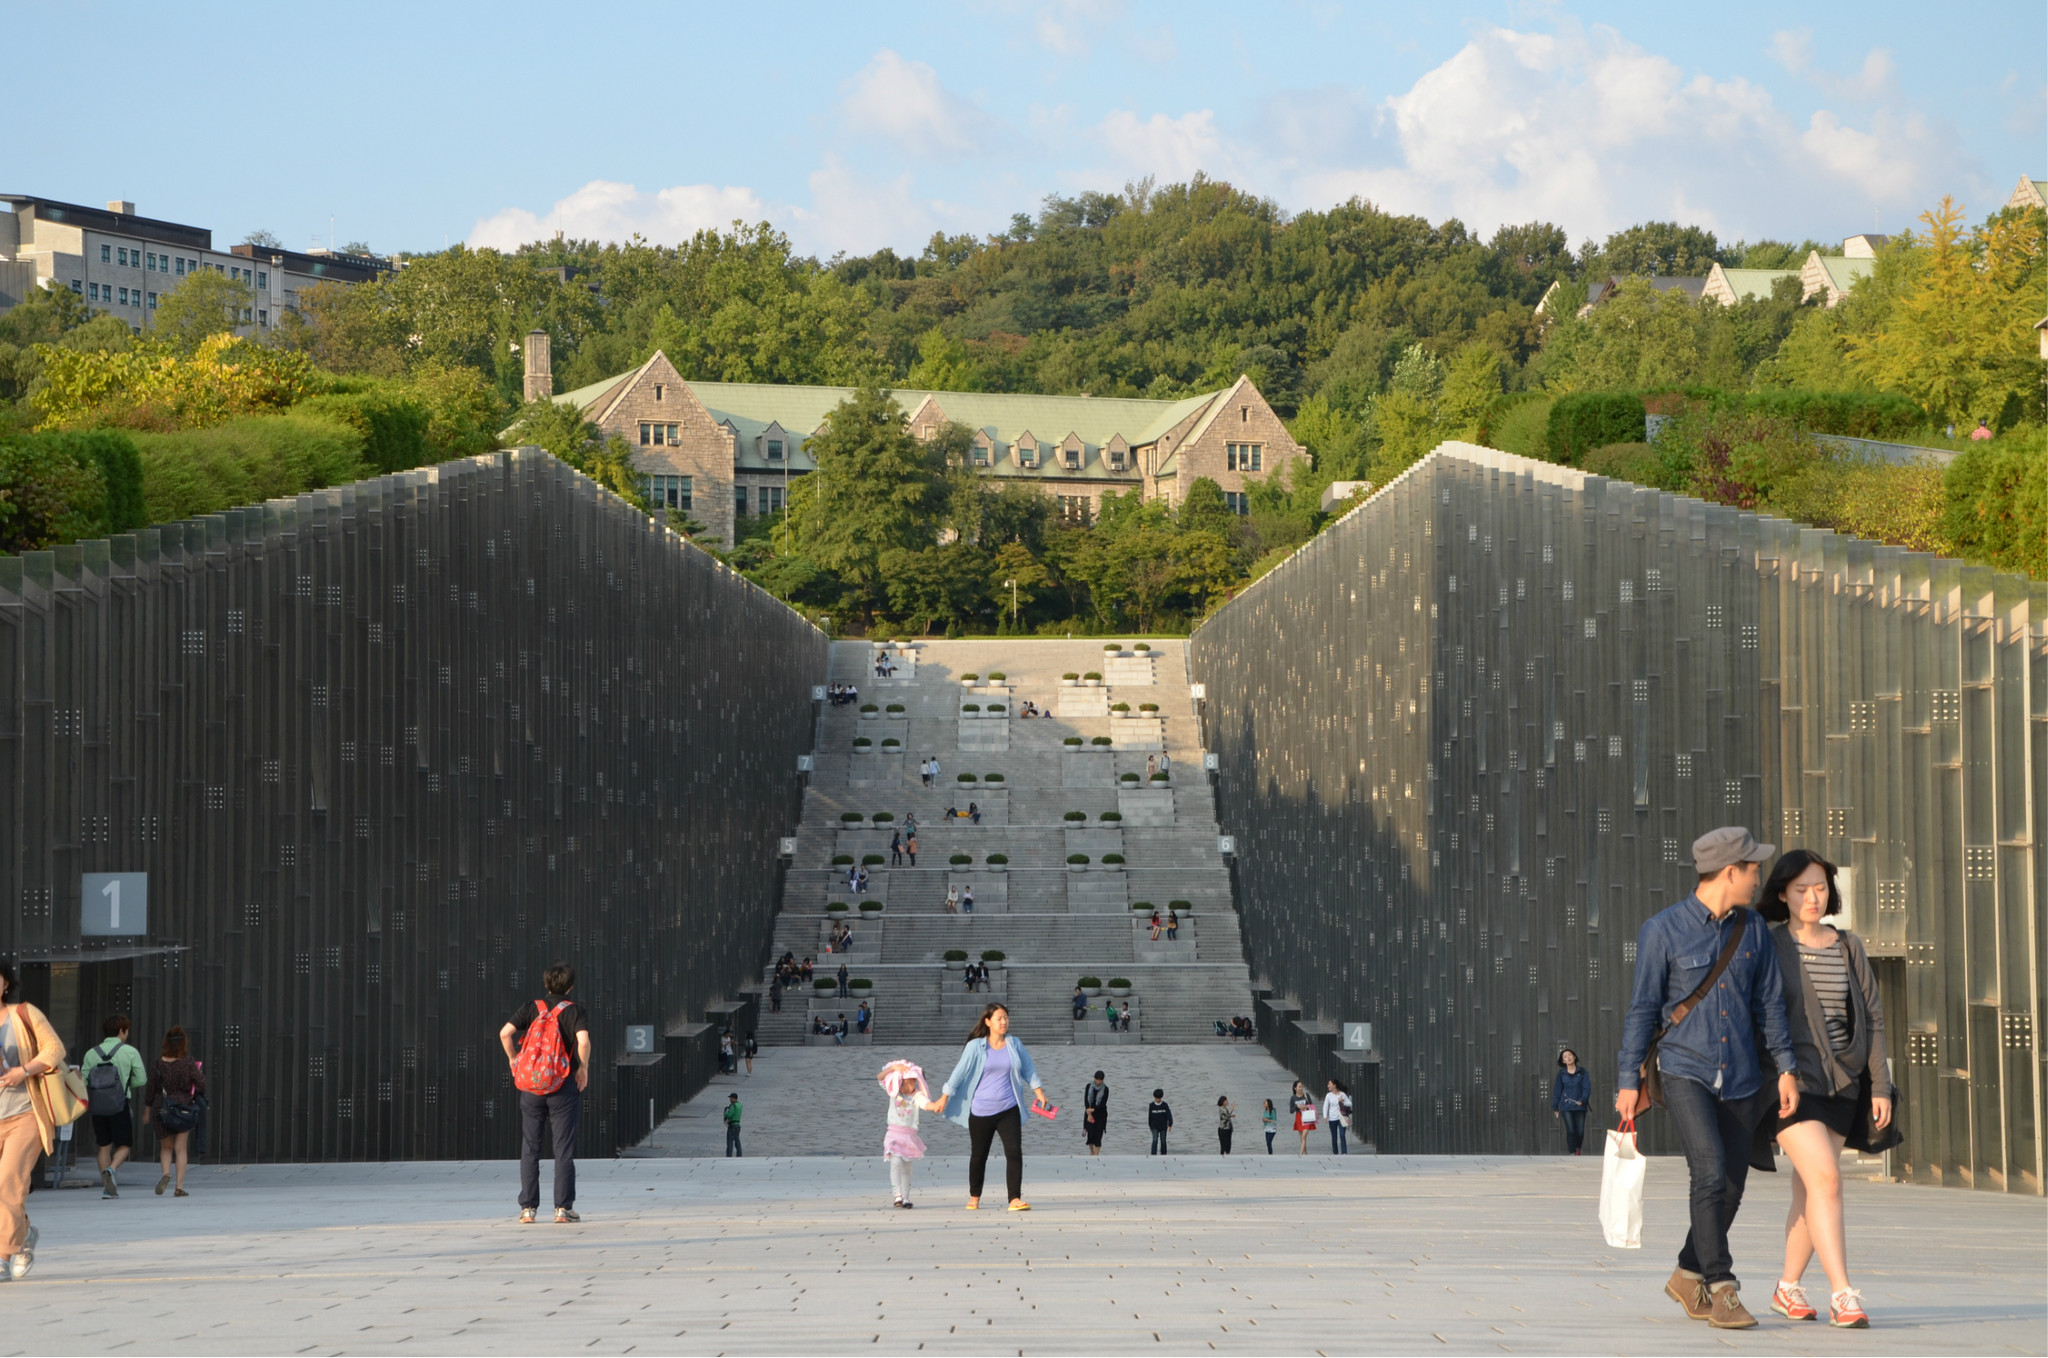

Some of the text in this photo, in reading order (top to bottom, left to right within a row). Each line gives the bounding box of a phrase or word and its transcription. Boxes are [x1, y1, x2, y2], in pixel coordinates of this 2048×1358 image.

[815, 687, 823, 698] 9
[1190, 685, 1204, 697] 10
[802, 757, 810, 768] 7
[1206, 755, 1214, 767] 8
[785, 839, 793, 852] 5
[1221, 837, 1230, 850] 6
[102, 880, 120, 928] 1
[634, 1028, 646, 1049] 3
[1350, 1025, 1365, 1047] 4
